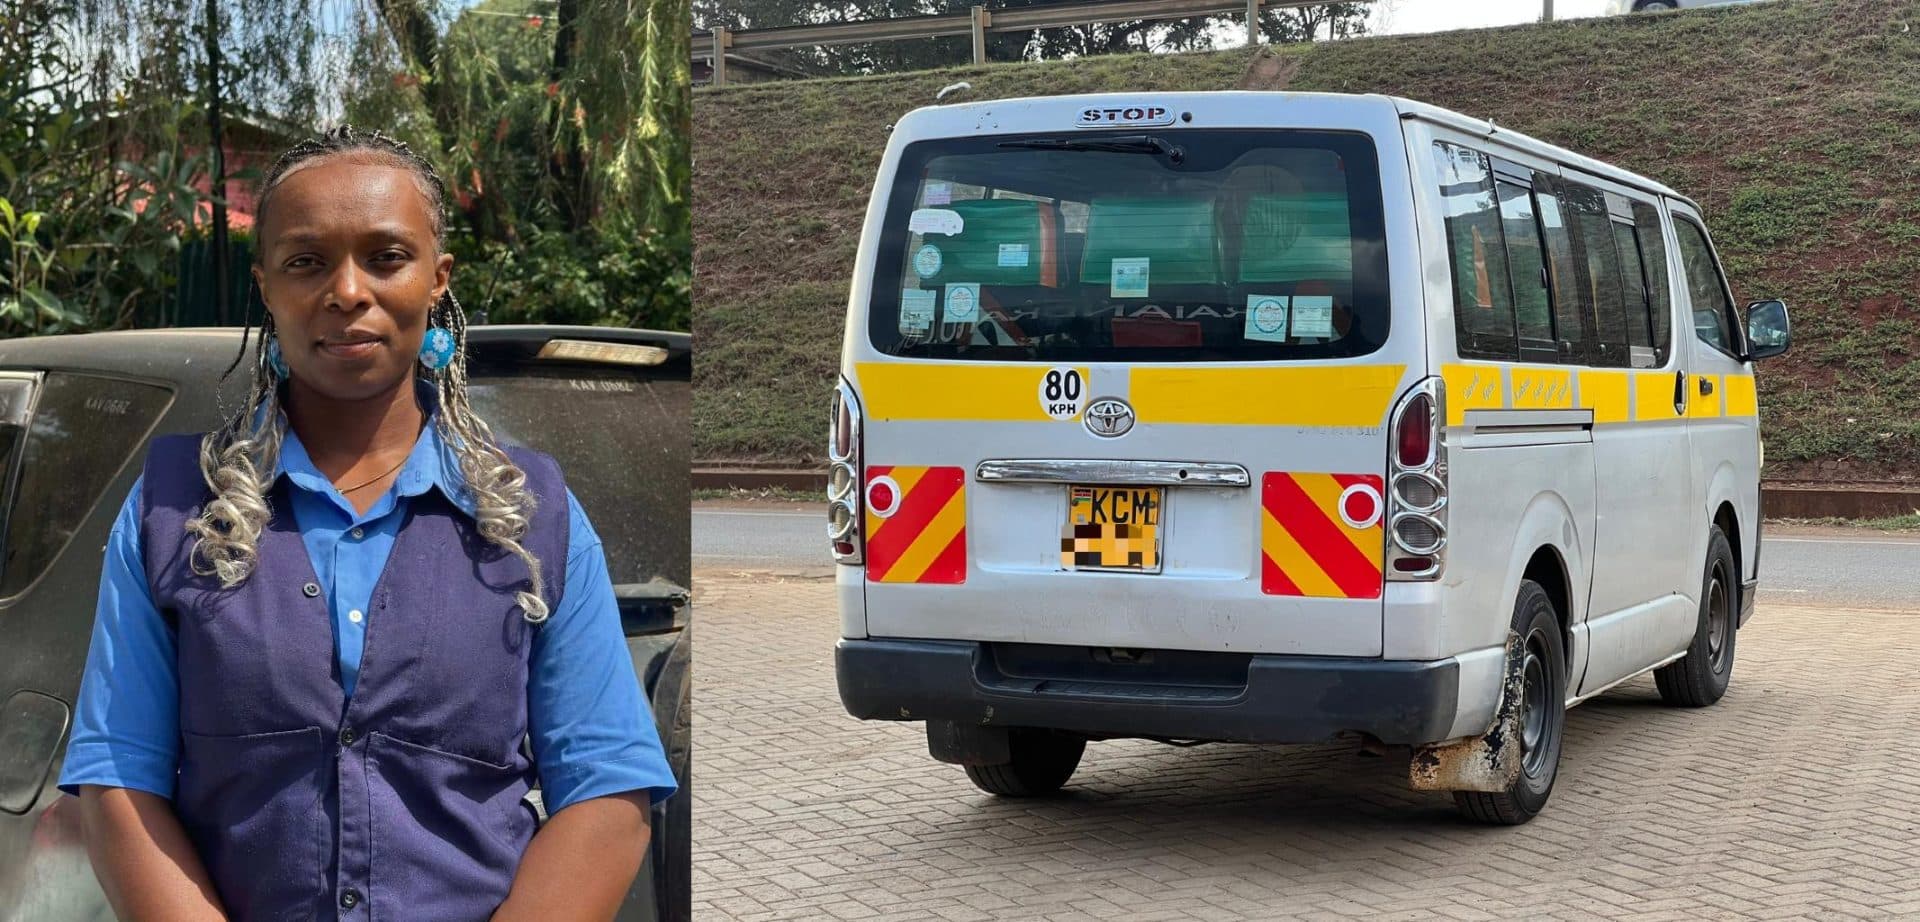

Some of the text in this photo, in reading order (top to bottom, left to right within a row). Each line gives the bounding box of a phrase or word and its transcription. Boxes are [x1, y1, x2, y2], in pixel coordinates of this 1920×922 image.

[1082, 107, 1166, 121] STOP
[1045, 370, 1081, 401] 80
[1049, 403, 1076, 415] KPH
[1091, 489, 1151, 524] KCM
